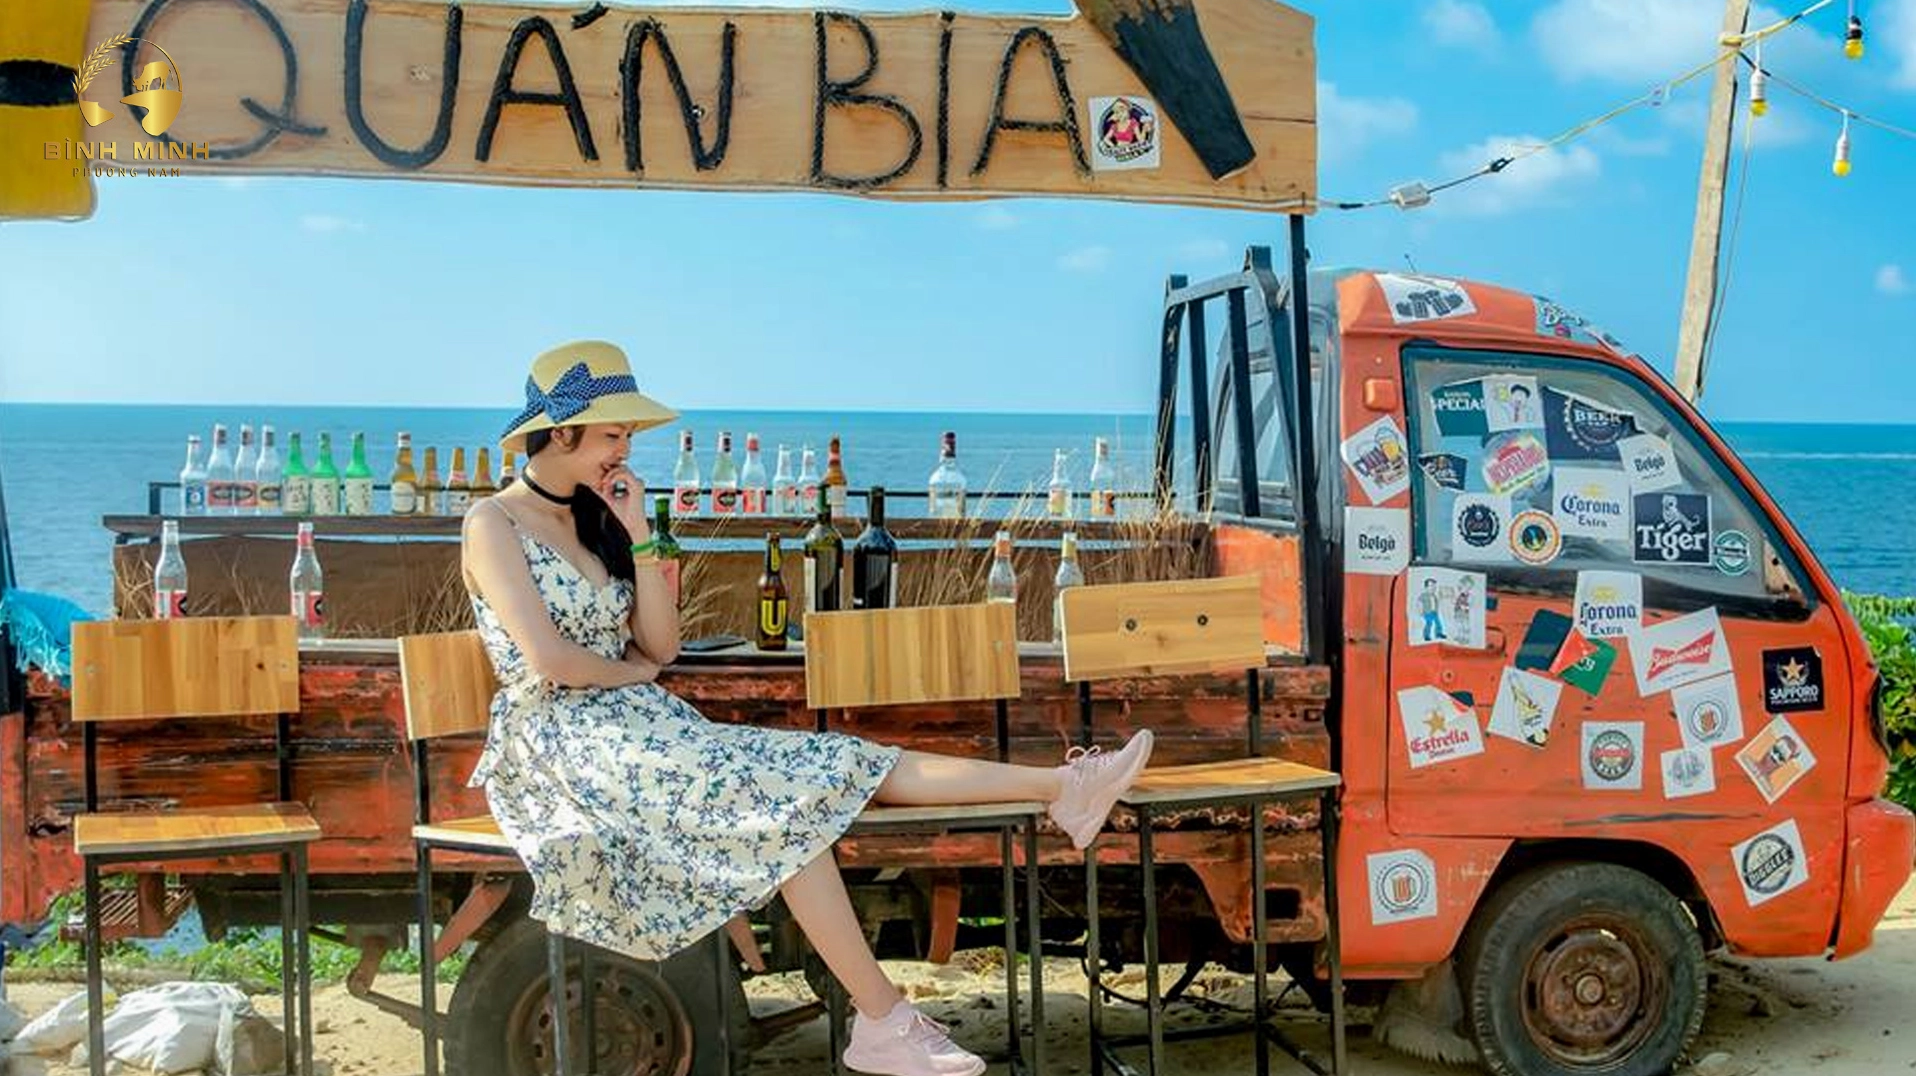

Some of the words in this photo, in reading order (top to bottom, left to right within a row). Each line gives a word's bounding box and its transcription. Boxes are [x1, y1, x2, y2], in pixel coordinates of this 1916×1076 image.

[812, 10, 1094, 190] BIA
[44, 138, 117, 160] BÌNH
[133, 141, 210, 160] MINH
[1561, 494, 1621, 516] Corona
[1578, 516, 1608, 528] Extra
[1636, 522, 1708, 561] Tiger
[1769, 684, 1819, 700] SAPPORO
[1410, 730, 1470, 753] Estrella
